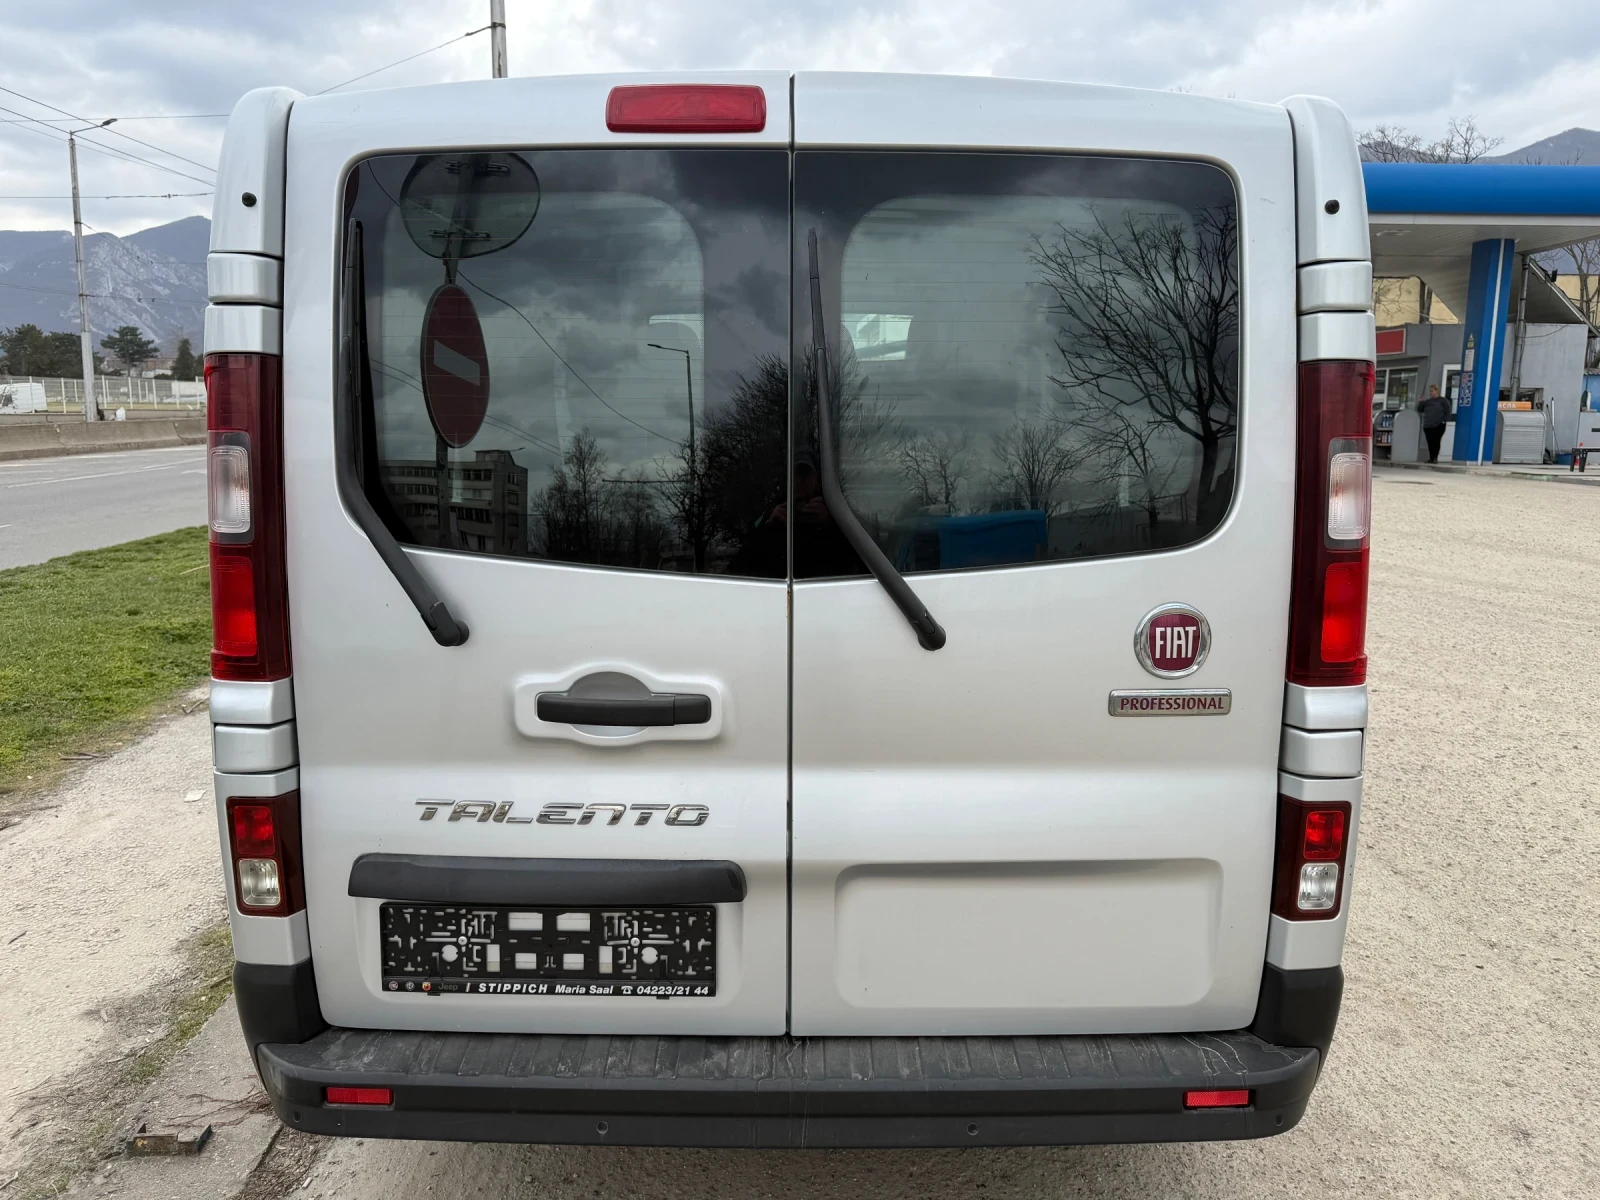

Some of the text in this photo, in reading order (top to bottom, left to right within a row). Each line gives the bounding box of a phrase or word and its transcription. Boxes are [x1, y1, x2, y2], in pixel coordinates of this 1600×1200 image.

[1155, 626, 1197, 659] FIAT
[1120, 696, 1224, 711] PROFESSIONAL
[415, 798, 710, 827] TALENTO
[438, 982, 709, 995] Jeep STIPPICH Maria Saal 04223/21 44
